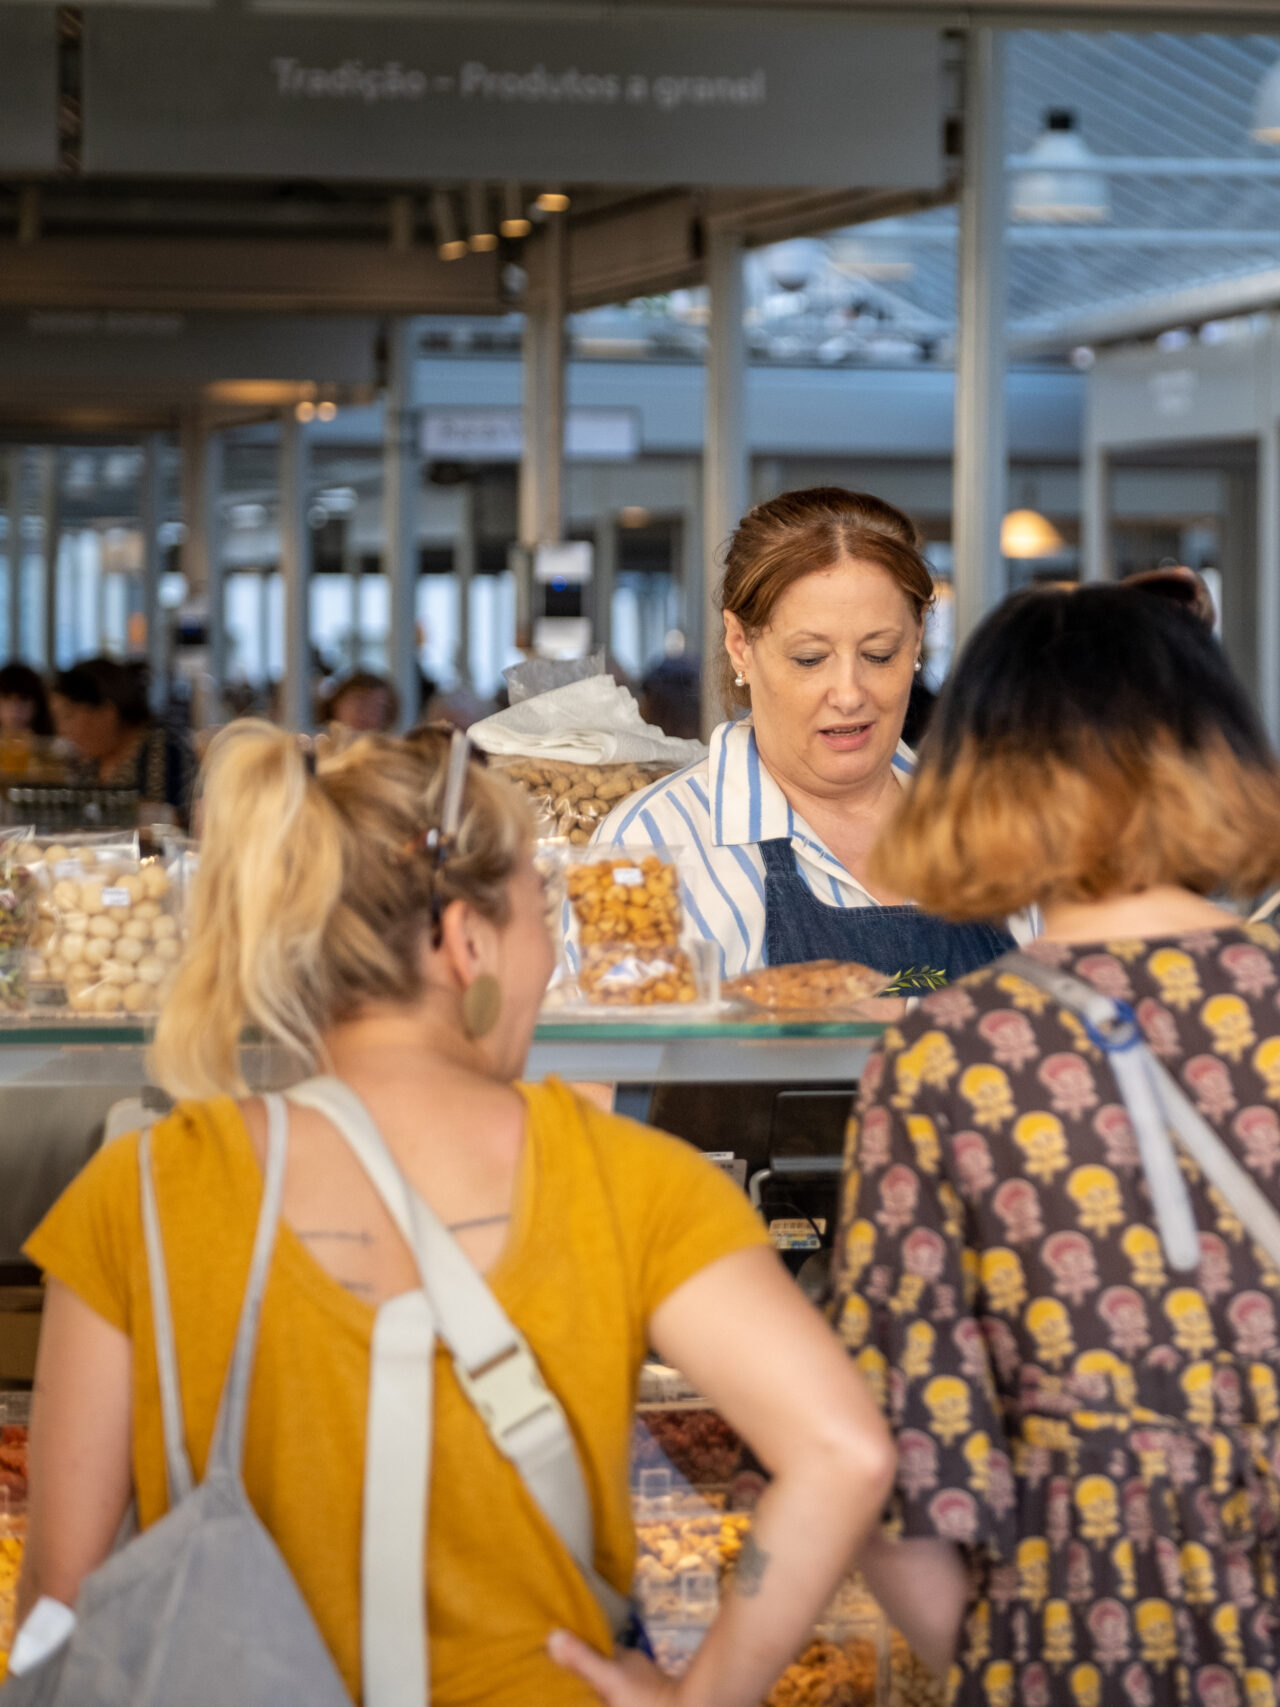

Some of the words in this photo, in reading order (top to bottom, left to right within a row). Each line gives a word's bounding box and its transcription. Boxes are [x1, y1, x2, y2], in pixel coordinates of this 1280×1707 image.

[275, 57, 427, 103] Tradição
[461, 61, 620, 97] Produtos
[627, 76, 648, 98] a
[653, 71, 766, 109] granel
